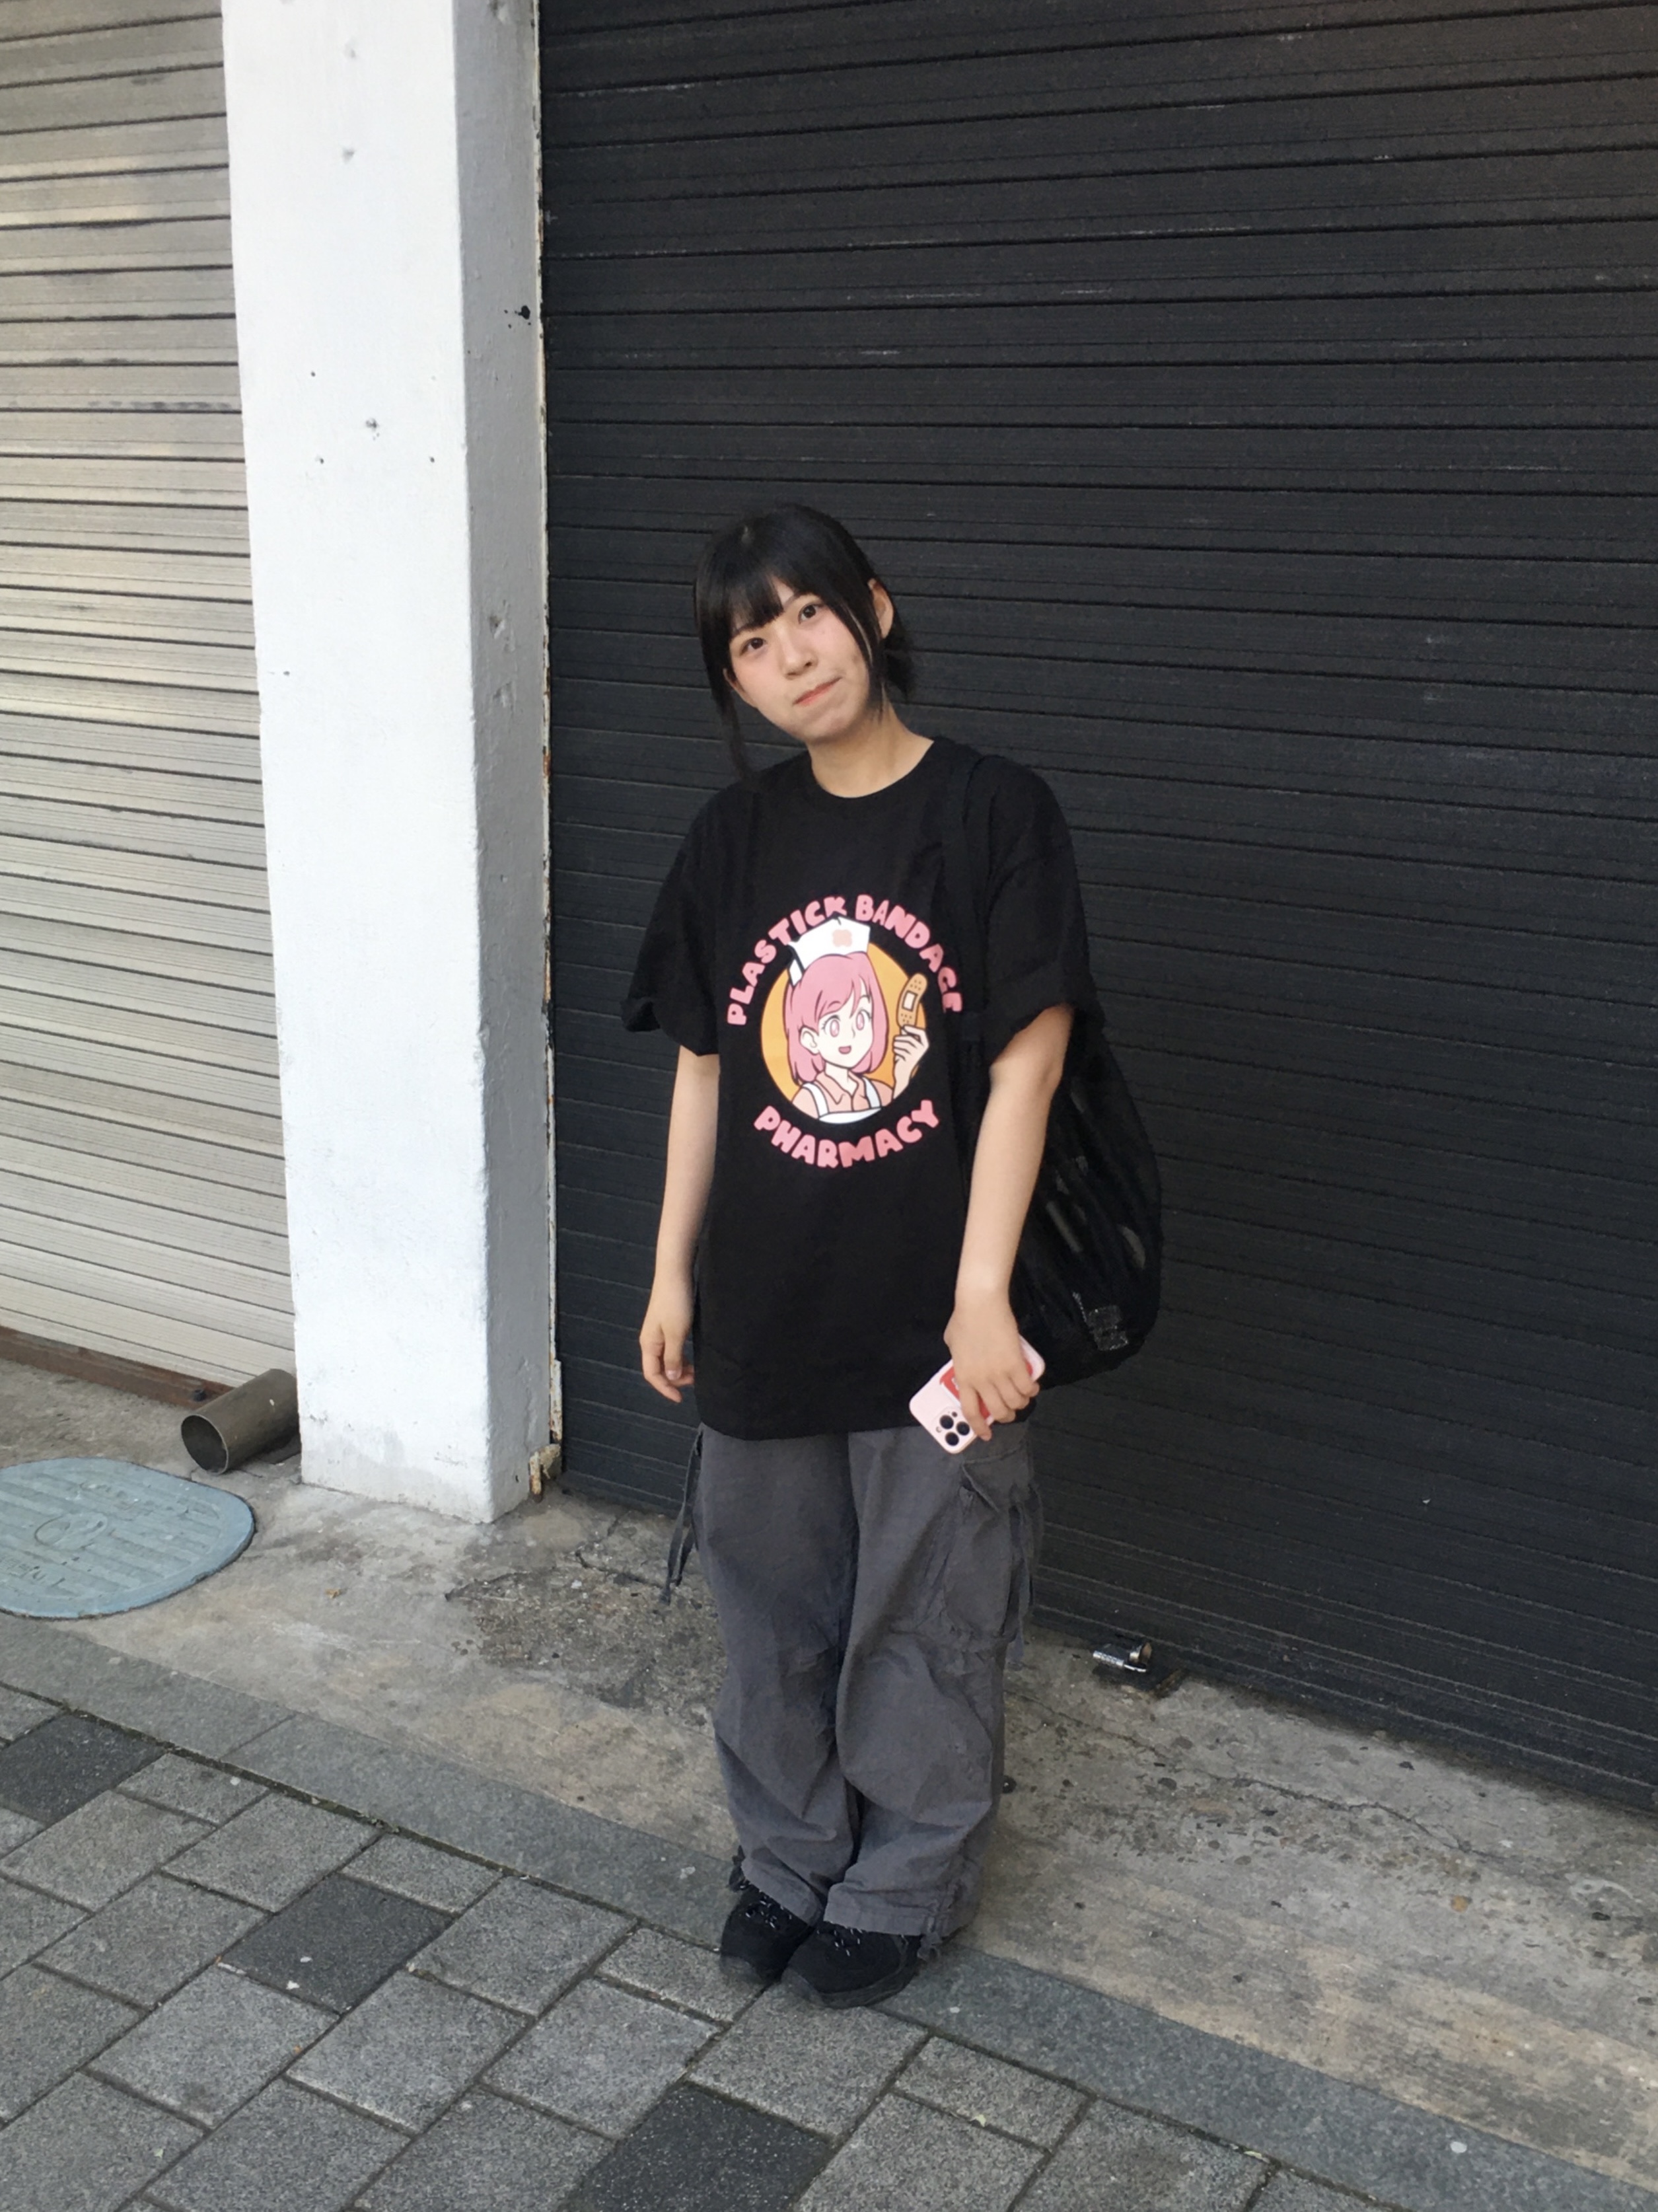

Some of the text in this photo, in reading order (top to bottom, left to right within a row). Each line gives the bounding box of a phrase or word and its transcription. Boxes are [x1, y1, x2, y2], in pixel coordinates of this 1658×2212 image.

[727, 894, 962, 1025] PLASTICK BANDAGE
[754, 1099, 939, 1169] PHARMACY
